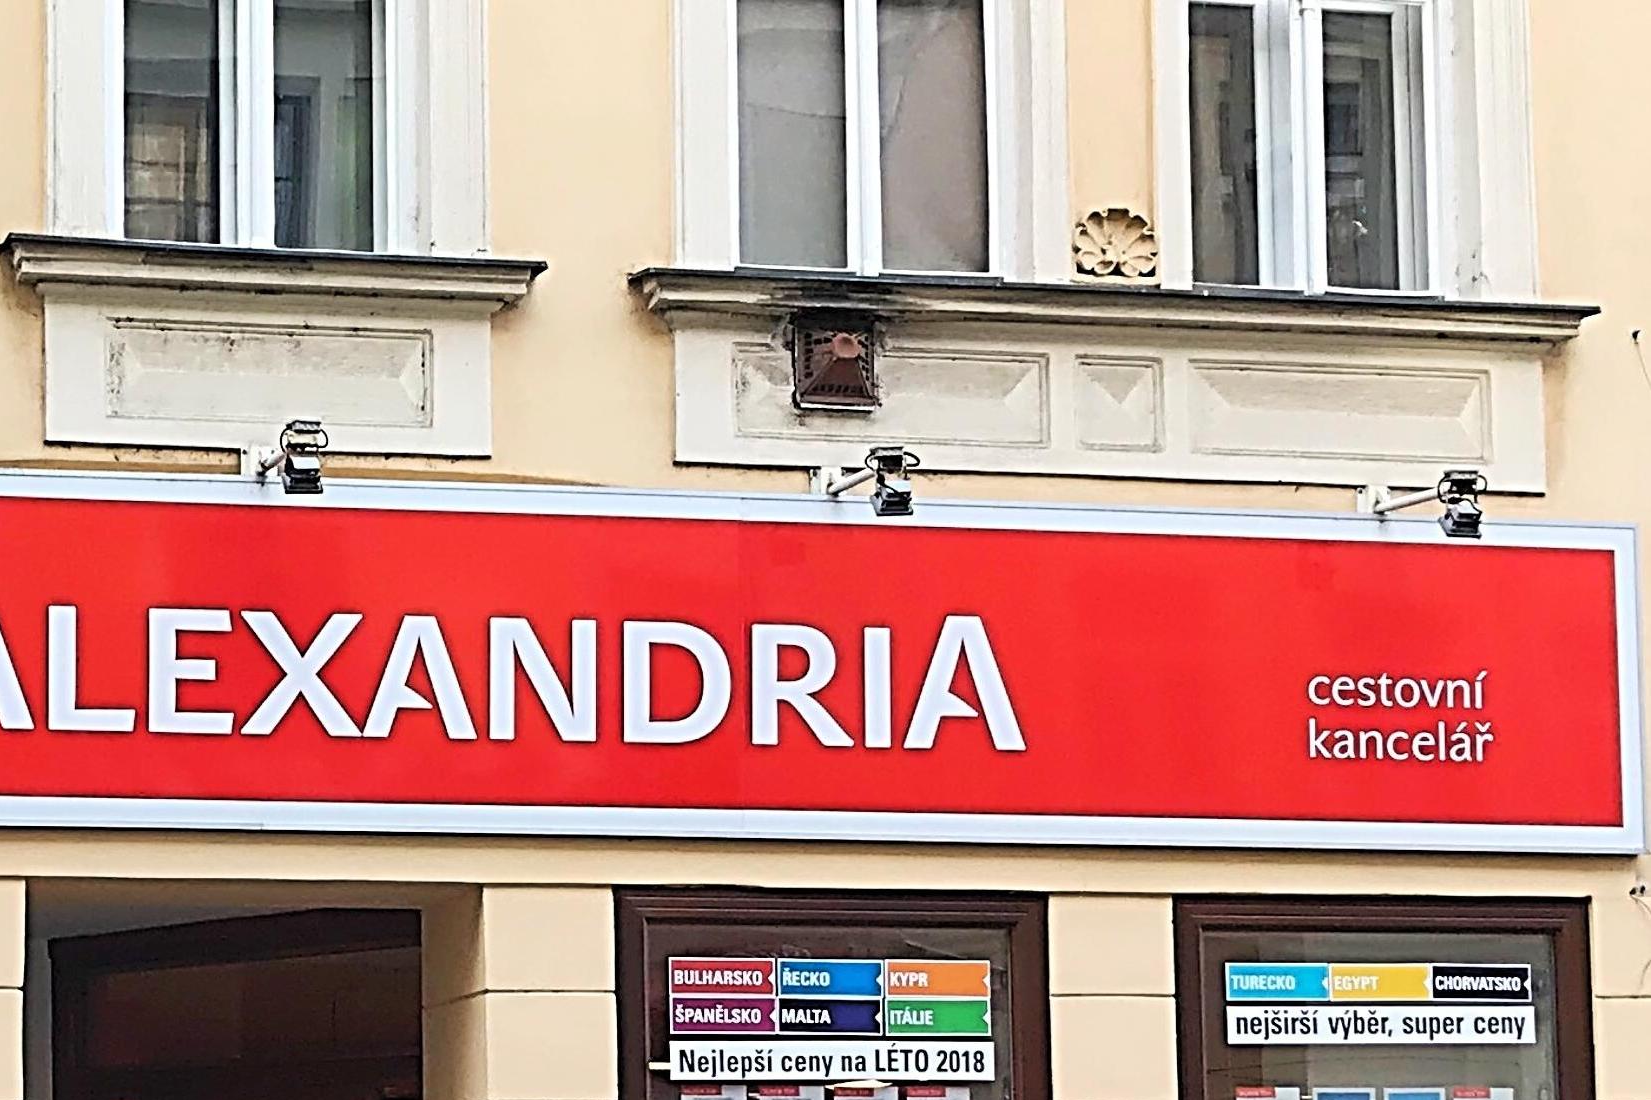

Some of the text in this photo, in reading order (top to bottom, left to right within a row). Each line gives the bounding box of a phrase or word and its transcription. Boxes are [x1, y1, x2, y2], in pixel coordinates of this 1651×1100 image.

[1307, 670, 1488, 710] cestovní
[1307, 717, 1494, 762] kancelář
[673, 968, 763, 986] BULHARSKO
[782, 965, 830, 987] ŘECKO
[889, 971, 929, 988] KYPR
[1230, 974, 1296, 991] TURECKO
[1333, 974, 1380, 992] EGYPT
[1434, 974, 1522, 993] CHORVATSKO
[675, 1003, 762, 1024] ŠPANĚLSKO
[781, 1009, 831, 1025] MALTA
[889, 1006, 934, 1027] ITÁLIE
[1235, 1009, 1526, 1040] nejširší výběr, super ceny
[678, 1043, 986, 1080] Nejlepší ceny na LÉTO 2018
